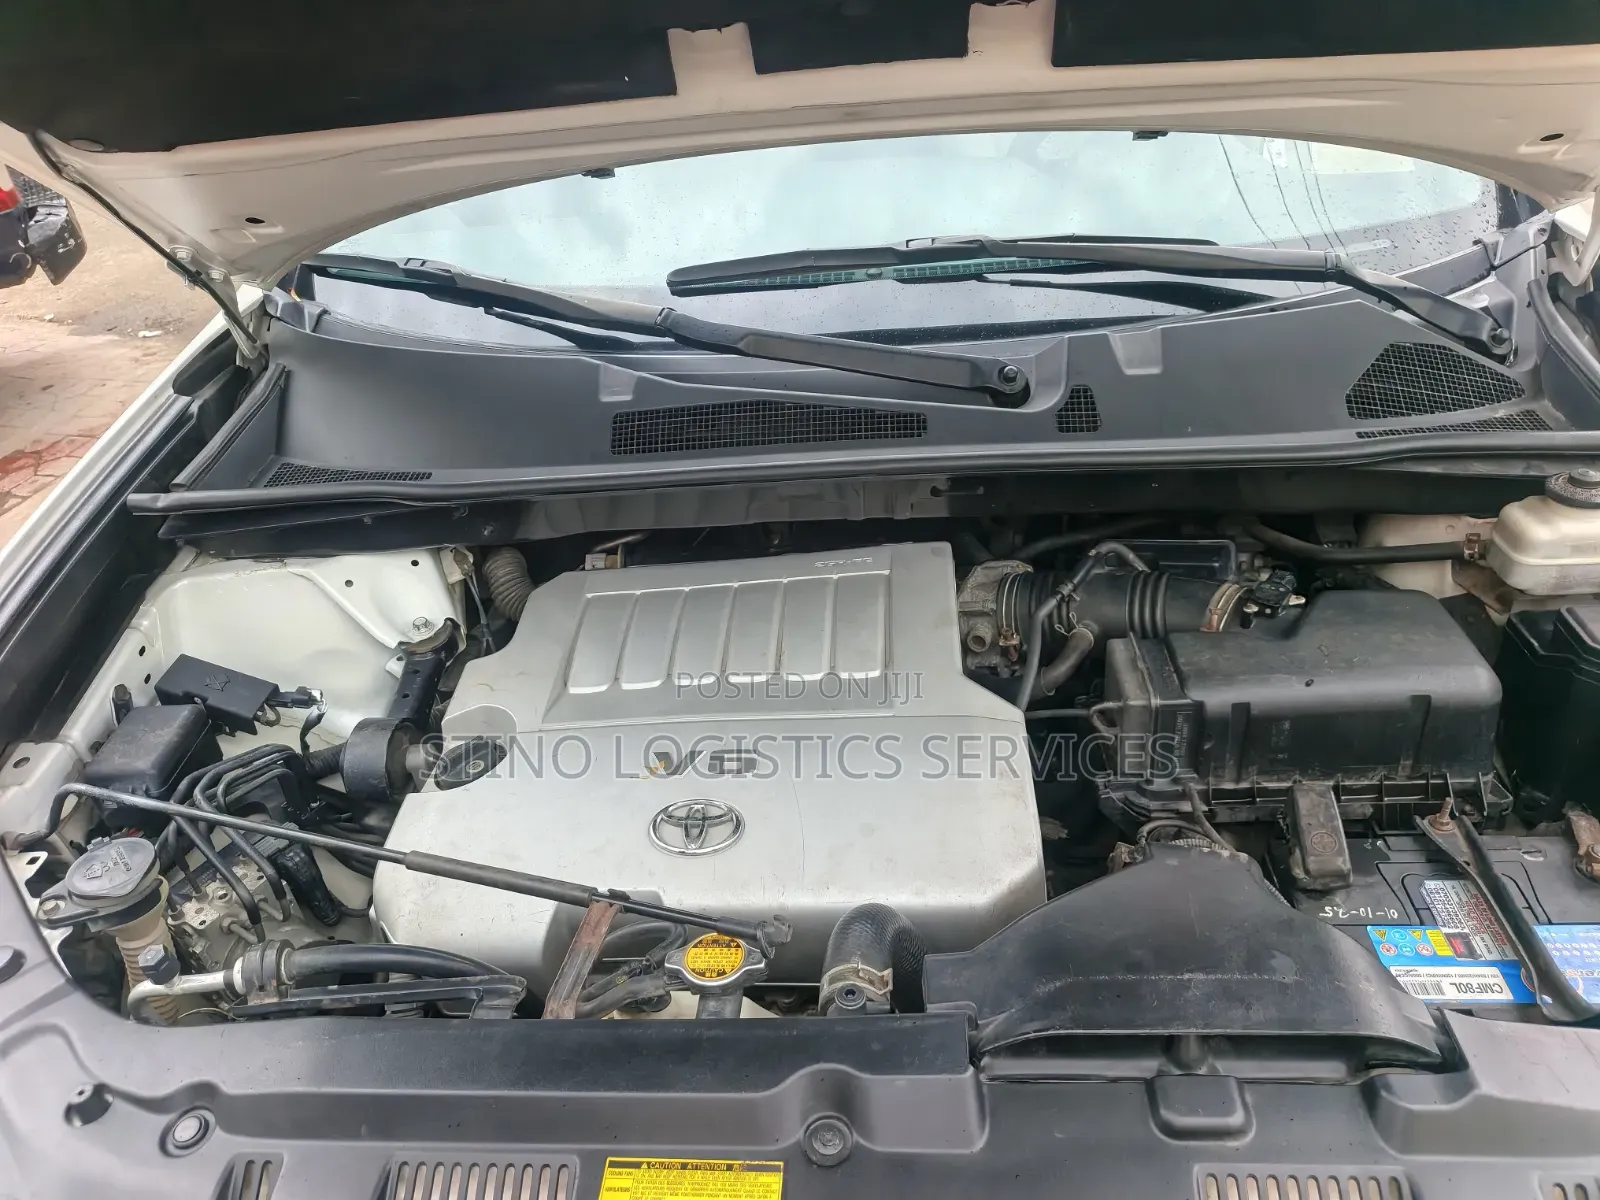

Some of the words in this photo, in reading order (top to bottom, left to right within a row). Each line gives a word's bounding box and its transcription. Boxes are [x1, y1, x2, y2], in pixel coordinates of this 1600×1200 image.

[1449, 982, 1504, 994] CMF80L
[649, 1162, 682, 1170] CAUTION
[686, 1163, 727, 1171] ATTENTION
